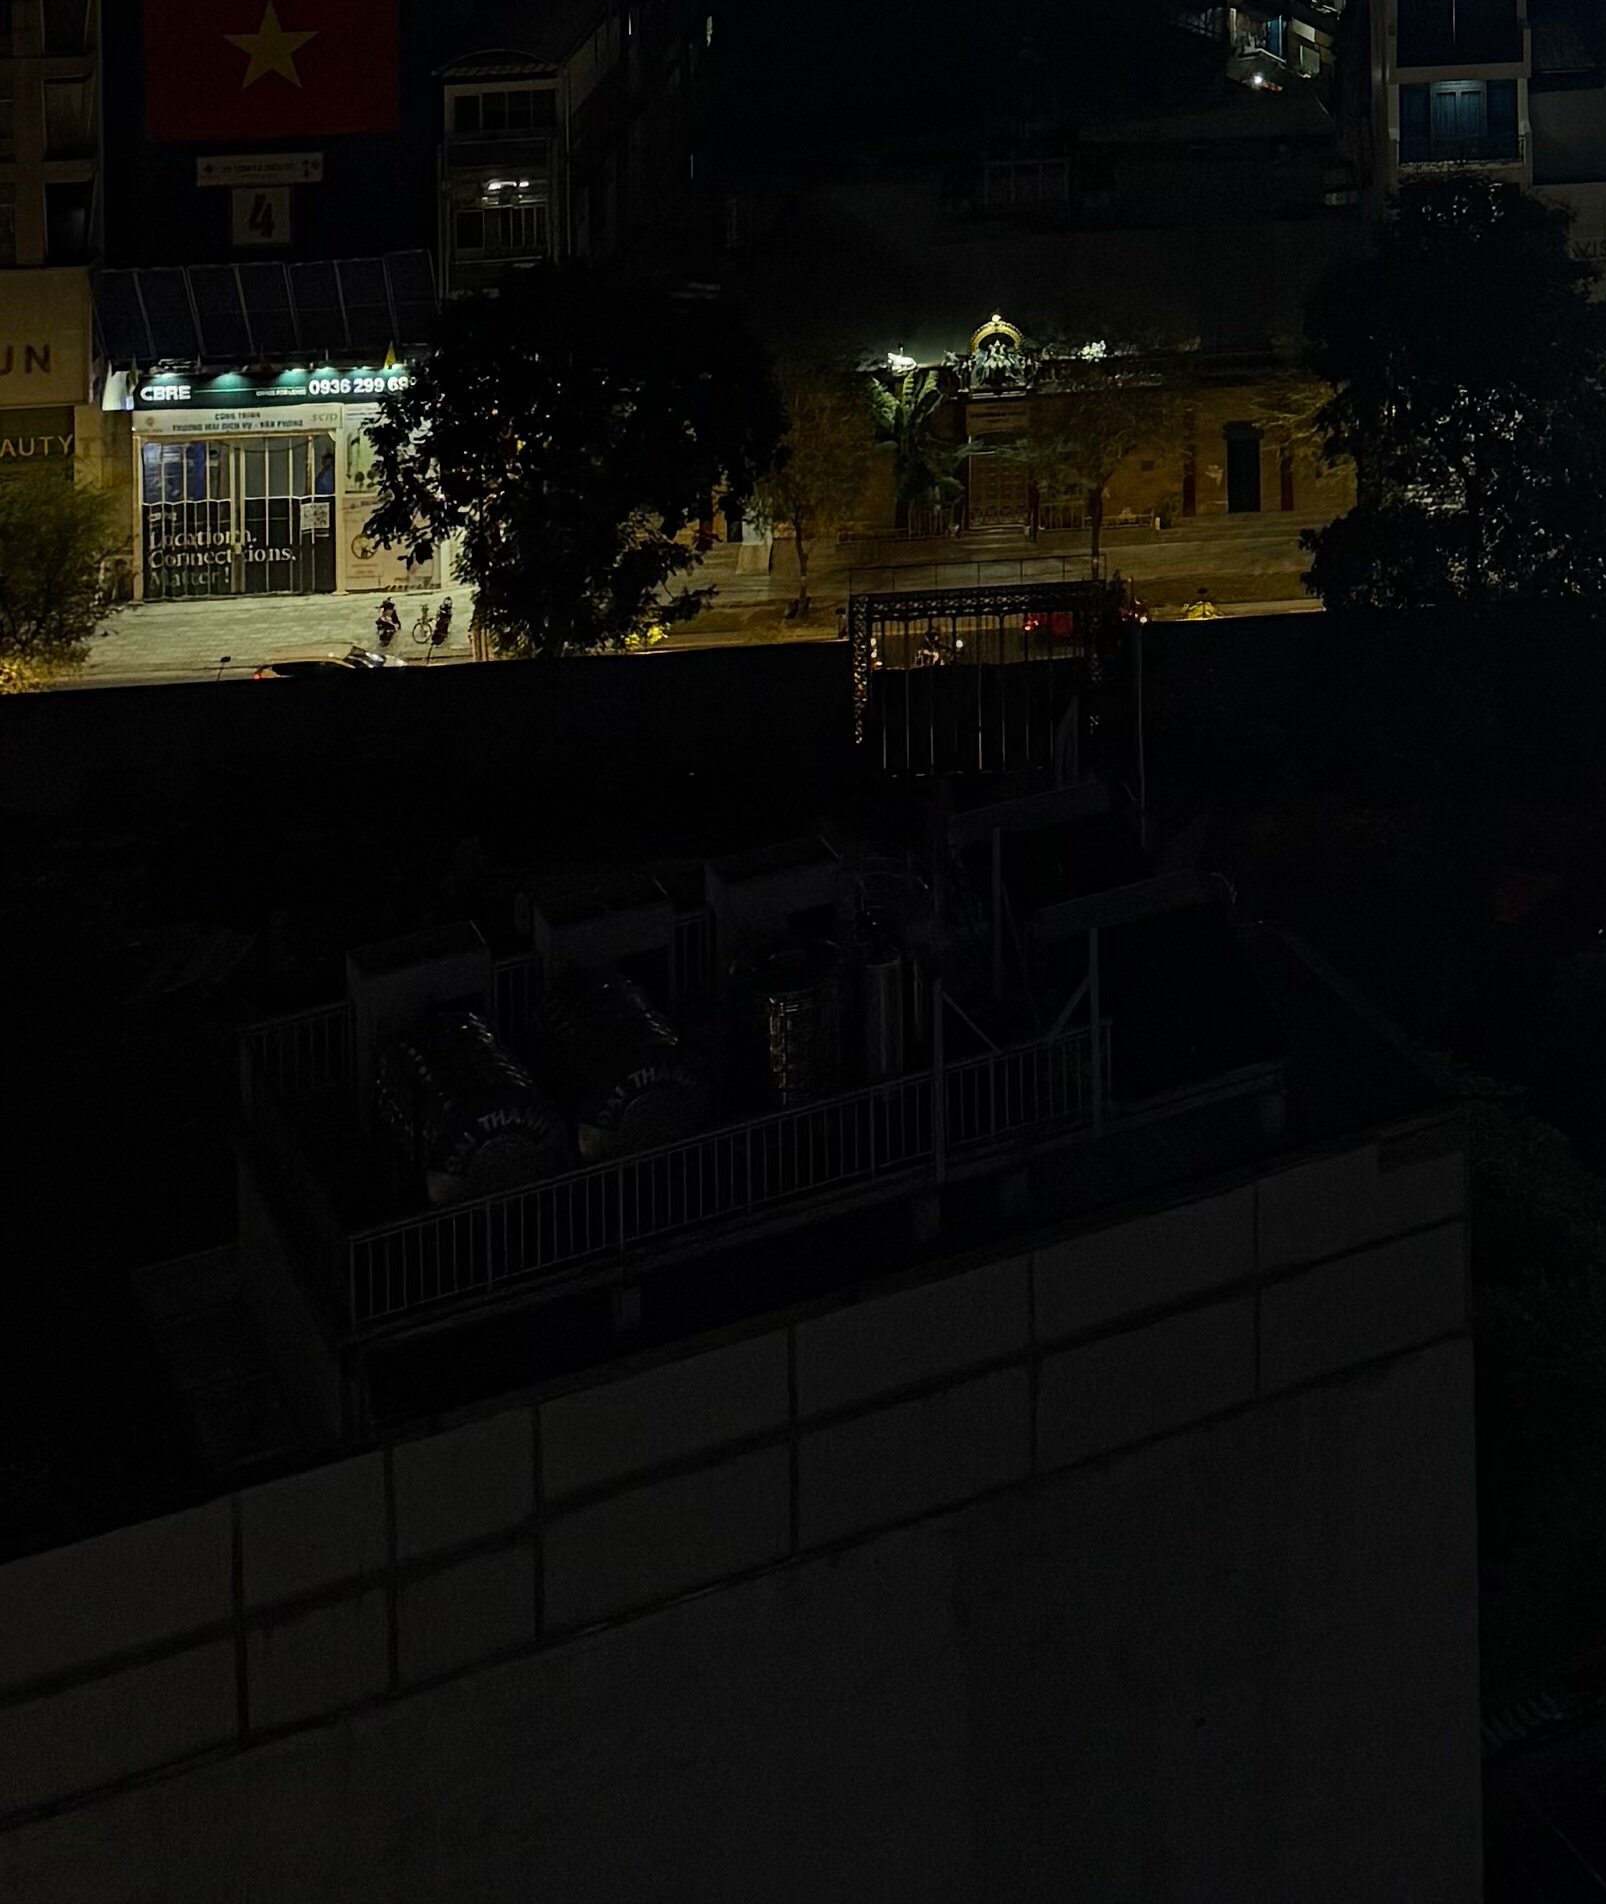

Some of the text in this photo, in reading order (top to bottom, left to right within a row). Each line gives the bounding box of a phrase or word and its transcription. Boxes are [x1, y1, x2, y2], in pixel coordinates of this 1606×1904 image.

[249, 193, 275, 239] 4
[139, 384, 192, 401] CBRE
[308, 379, 350, 396] 0936
[353, 377, 385, 394] 299
